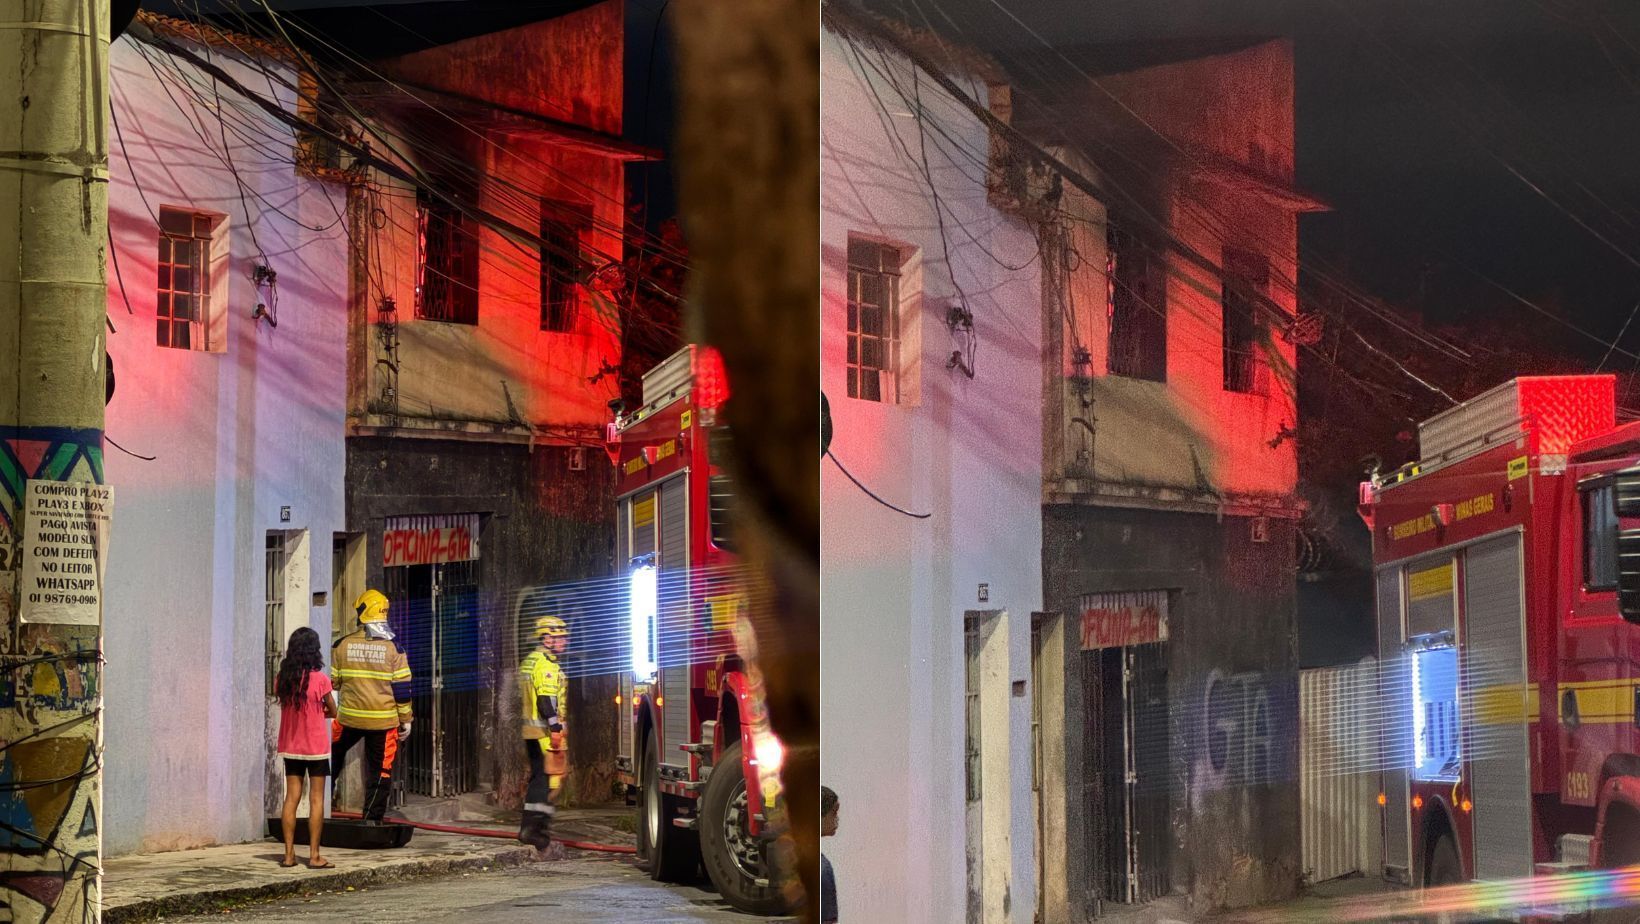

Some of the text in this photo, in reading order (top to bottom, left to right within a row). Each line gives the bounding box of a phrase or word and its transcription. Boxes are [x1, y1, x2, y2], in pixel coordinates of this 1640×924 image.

[34, 485, 109, 500] COMPRO PLAY2
[38, 499, 105, 513] PLAY3 E XBOX
[40, 519, 97, 531] PAGO AVISTA
[38, 532, 79, 544] MODELO
[33, 546, 98, 559] COM DEFEITO
[41, 562, 93, 574] NO LEITOR
[36, 577, 95, 590] WHATSAPP
[347, 643, 387, 652] BOMBEIRO
[347, 650, 385, 659] MILITAR
